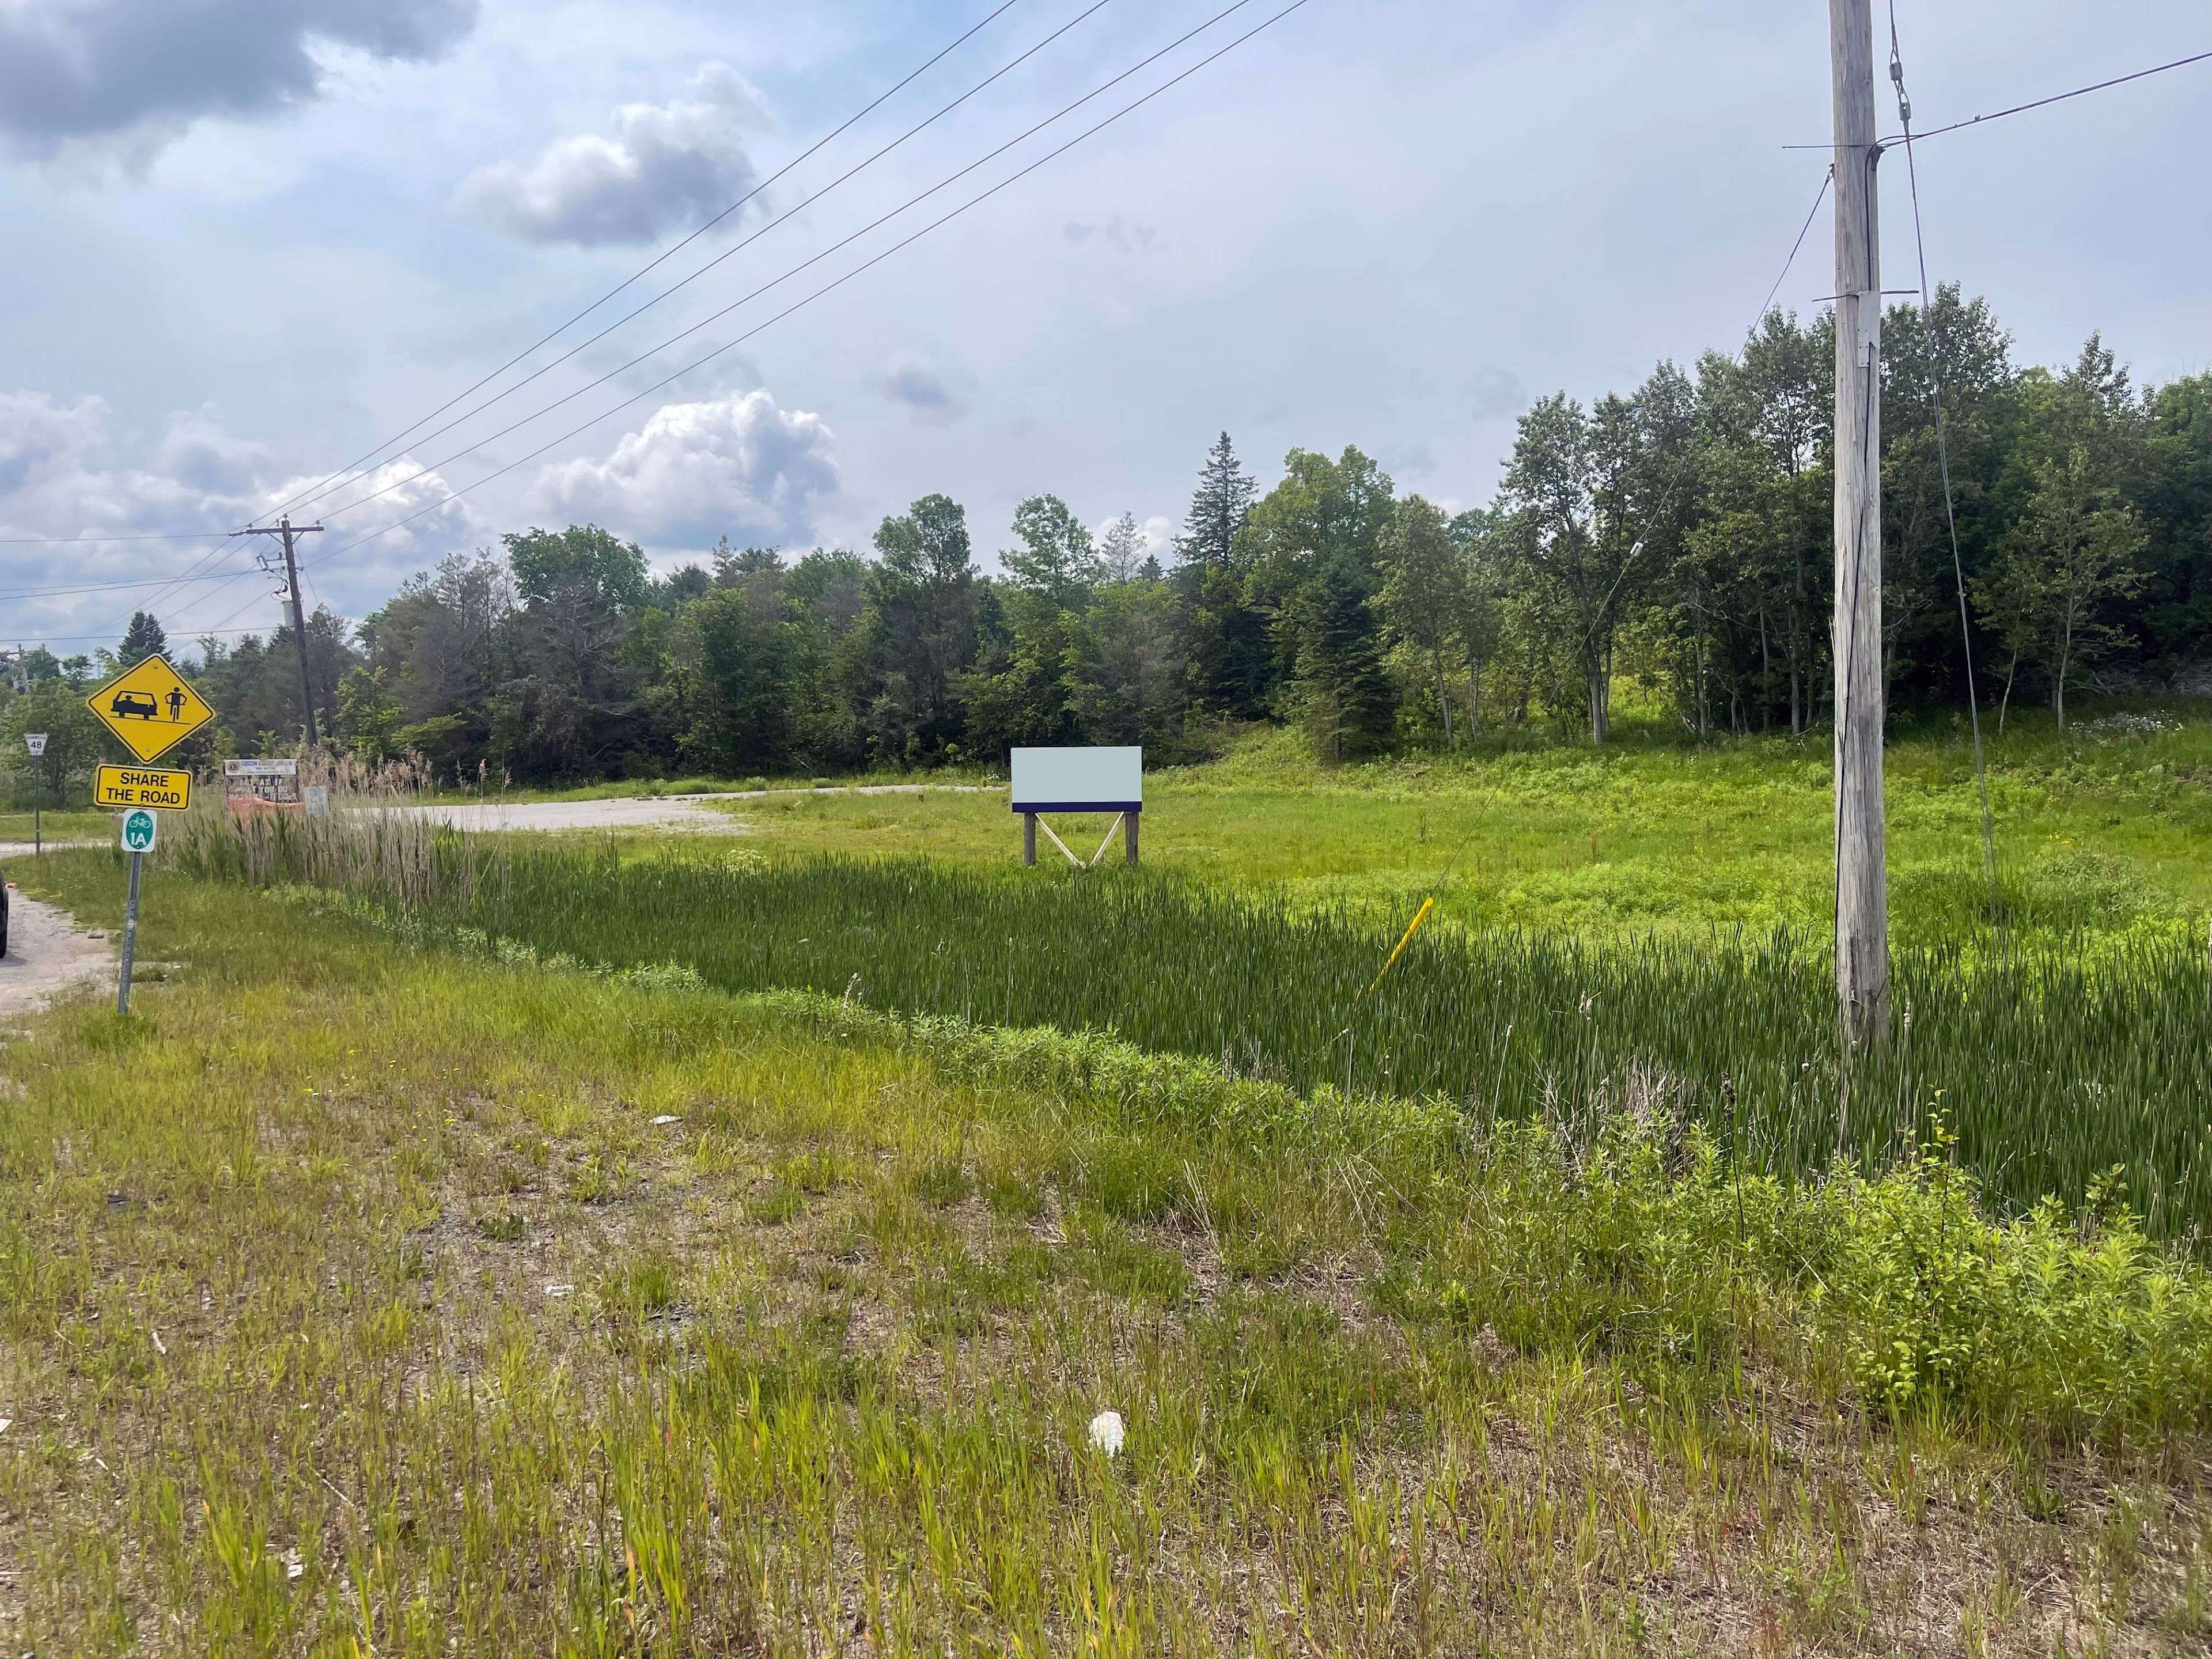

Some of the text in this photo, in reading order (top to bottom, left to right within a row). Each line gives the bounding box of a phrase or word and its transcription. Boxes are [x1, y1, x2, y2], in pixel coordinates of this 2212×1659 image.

[31, 741, 42, 749] 48
[120, 772, 169, 787] SHARE
[106, 787, 180, 804] THE ROAD
[130, 832, 147, 846] 1A
